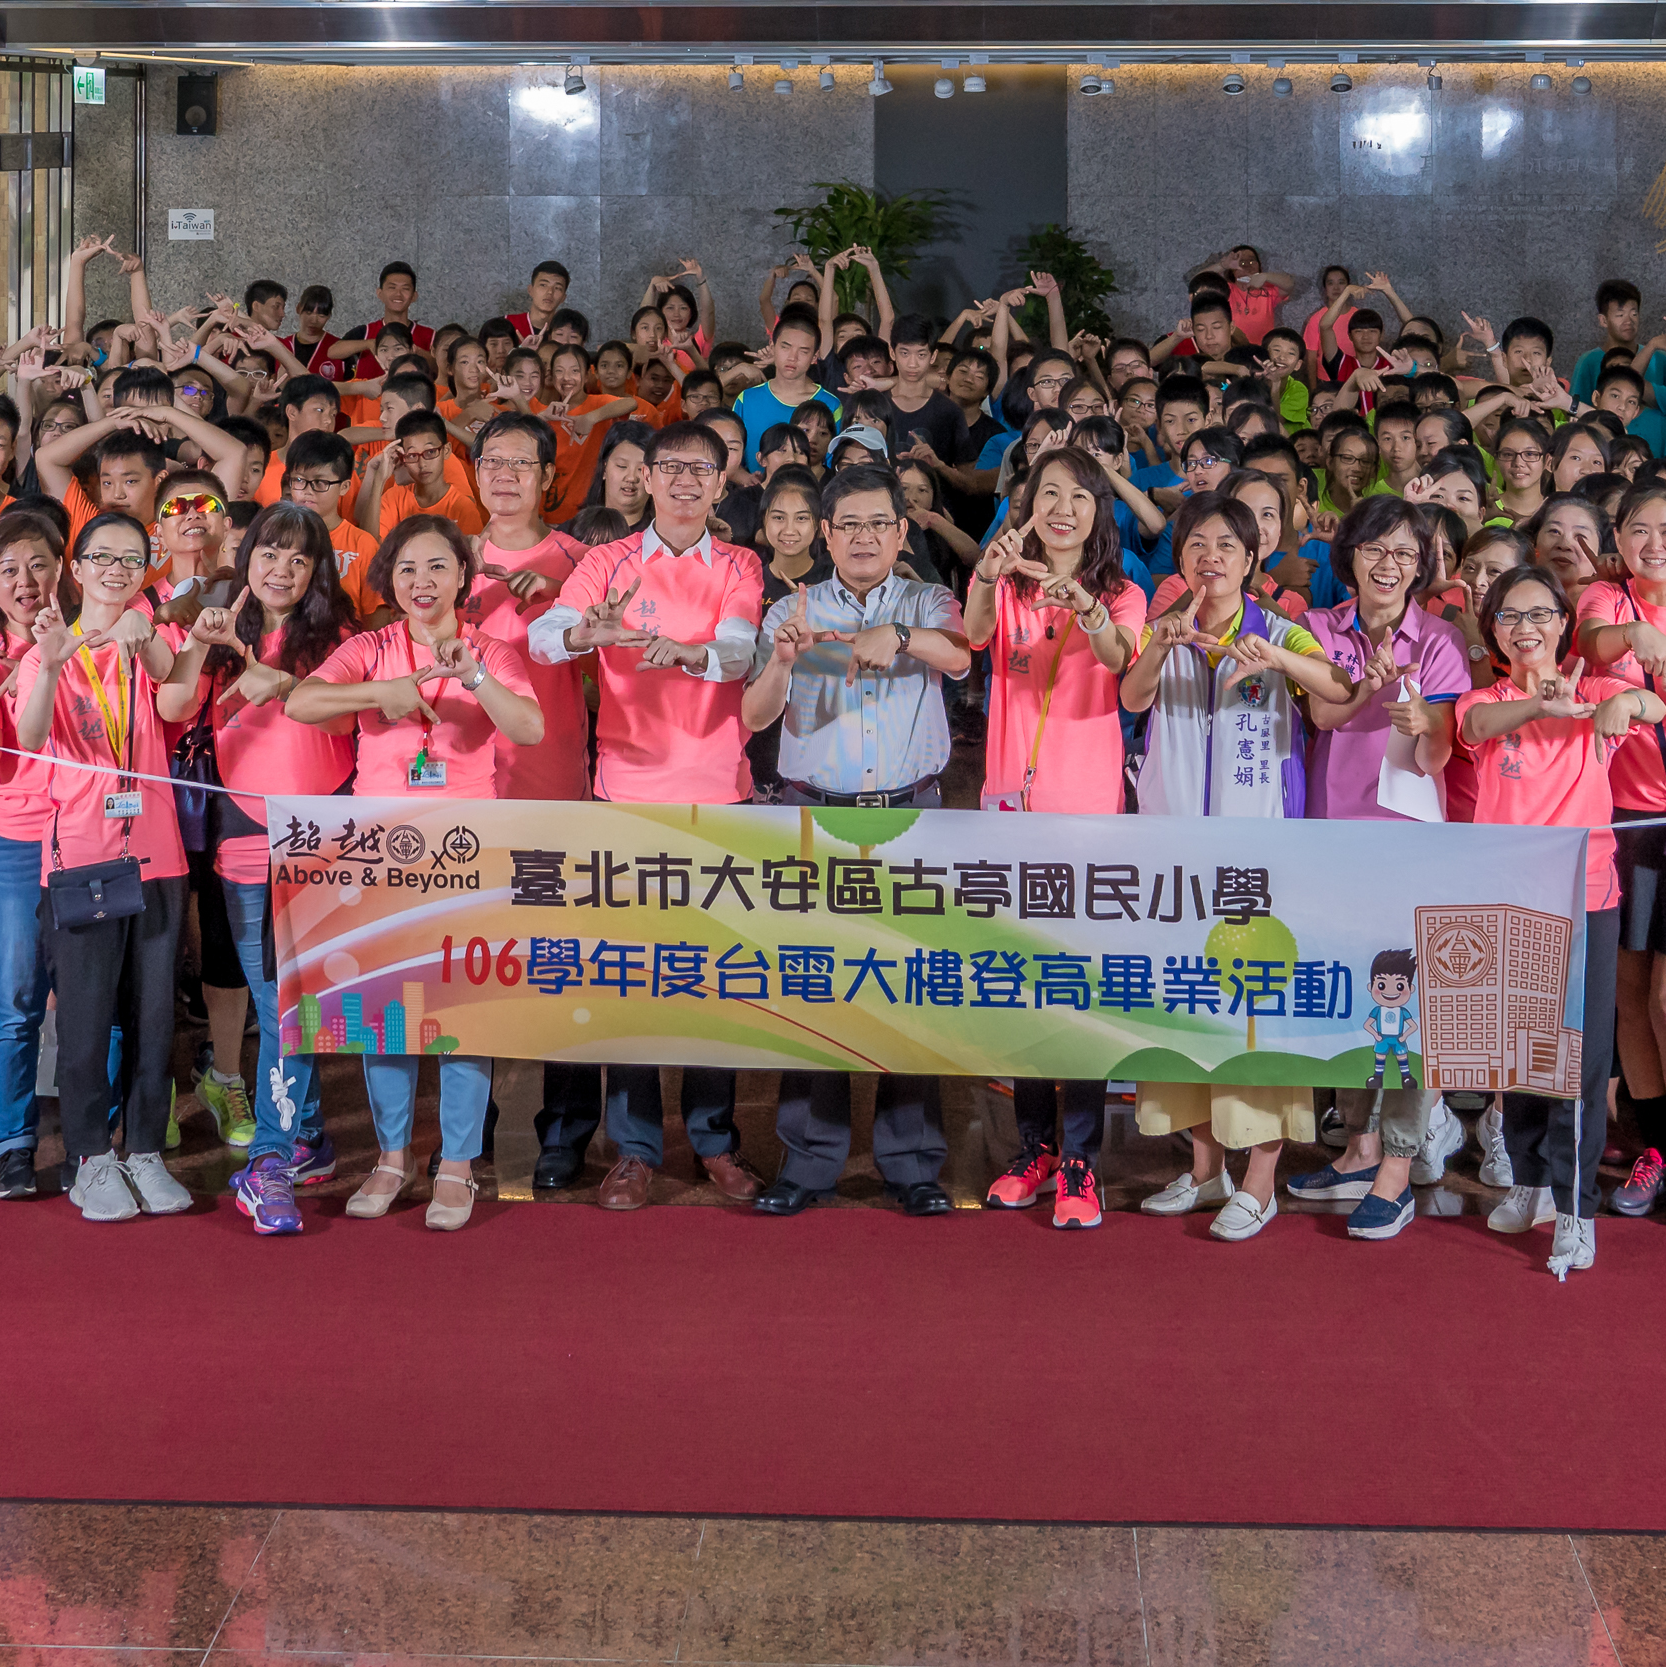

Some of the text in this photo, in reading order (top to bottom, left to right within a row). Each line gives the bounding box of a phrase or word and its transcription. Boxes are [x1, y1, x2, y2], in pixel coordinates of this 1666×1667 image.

[1006, 626, 1032, 674] 超越
[73, 694, 105, 740] 超越
[1234, 713, 1258, 787] 孔憲娟
[1259, 760, 1271, 785] 里長
[1497, 734, 1525, 780] 超越
[272, 815, 386, 864] 超越
[275, 865, 480, 893] Above & Beyond
[509, 849, 1272, 926] 臺北市大安區古亭國民小學
[441, 935, 1353, 1019] 106學年度台電大樓登高畢業活動
